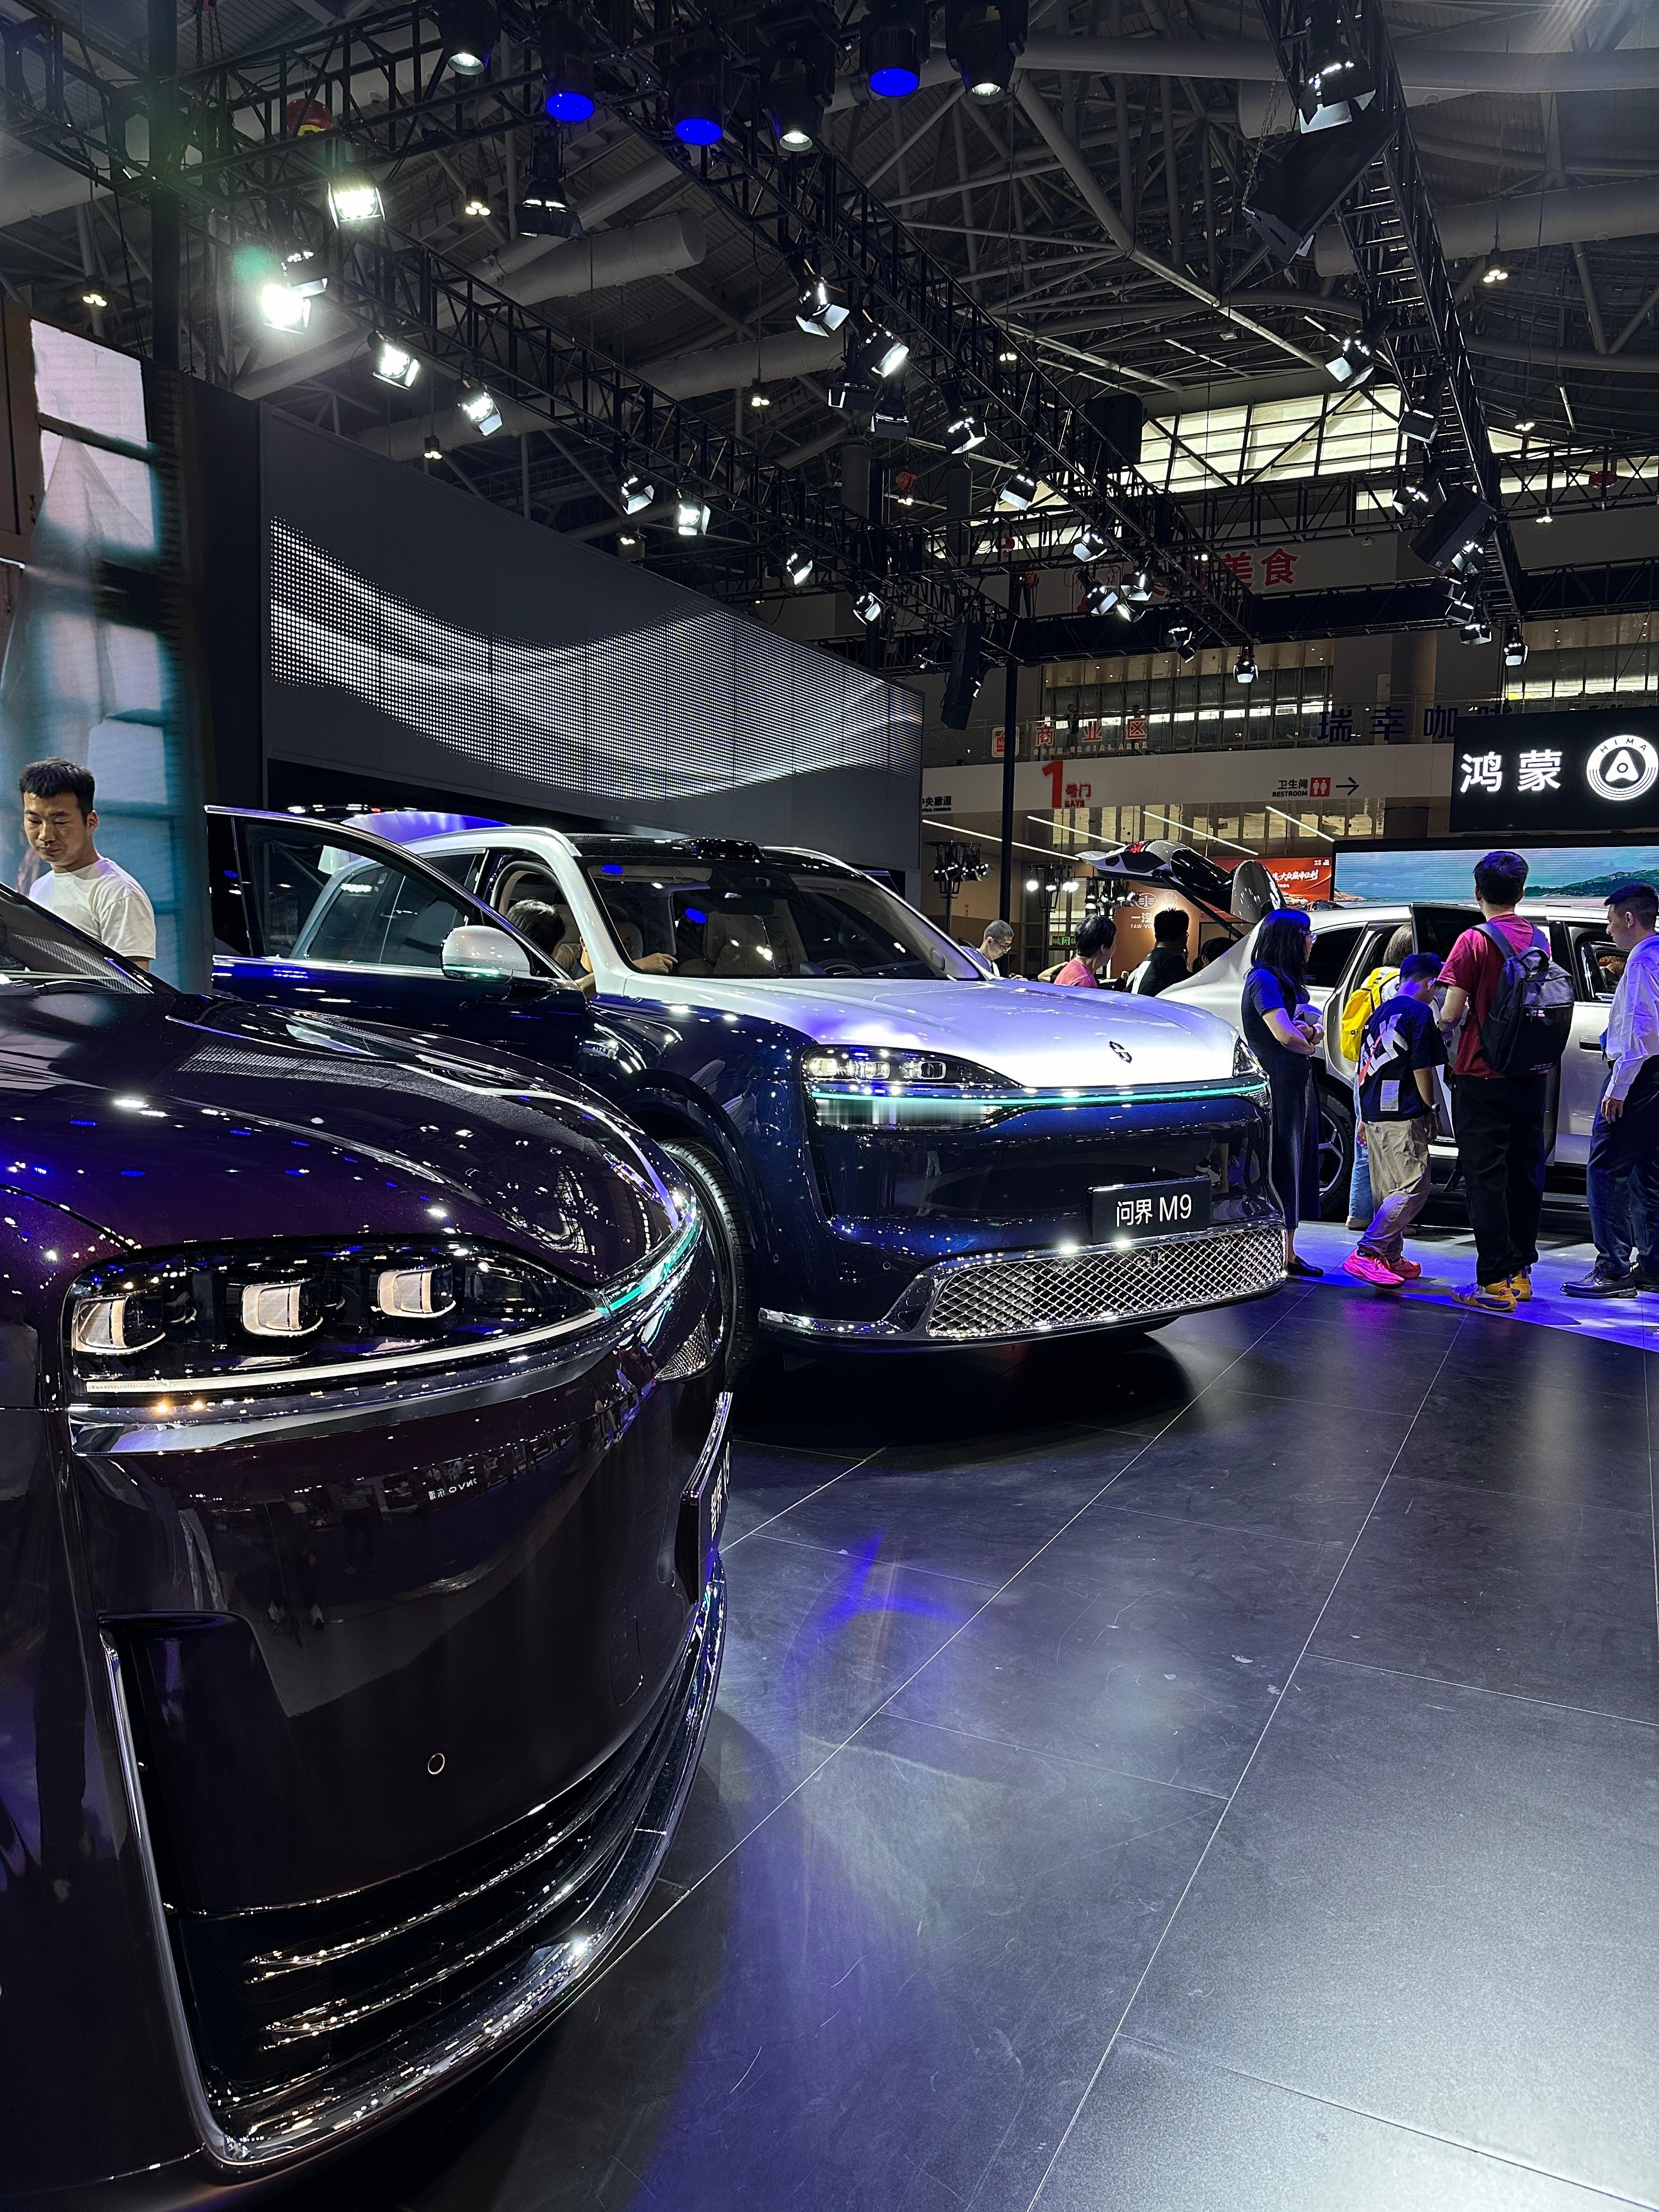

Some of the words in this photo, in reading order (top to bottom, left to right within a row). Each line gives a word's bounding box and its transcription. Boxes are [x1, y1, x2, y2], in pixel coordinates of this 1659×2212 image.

[1035, 718, 1147, 747] 商业区
[1317, 703, 1513, 742] 瑞幸咖
[1118, 742, 1148, 751] AREA
[1600, 738, 1646, 753] HIMA
[1460, 749, 1562, 793] 鸿蒙
[1278, 779, 1308, 789] 卫生间
[1064, 799, 1085, 808] GATE
[1116, 1199, 1153, 1227] 问界
[1159, 1194, 1192, 1222] M9
